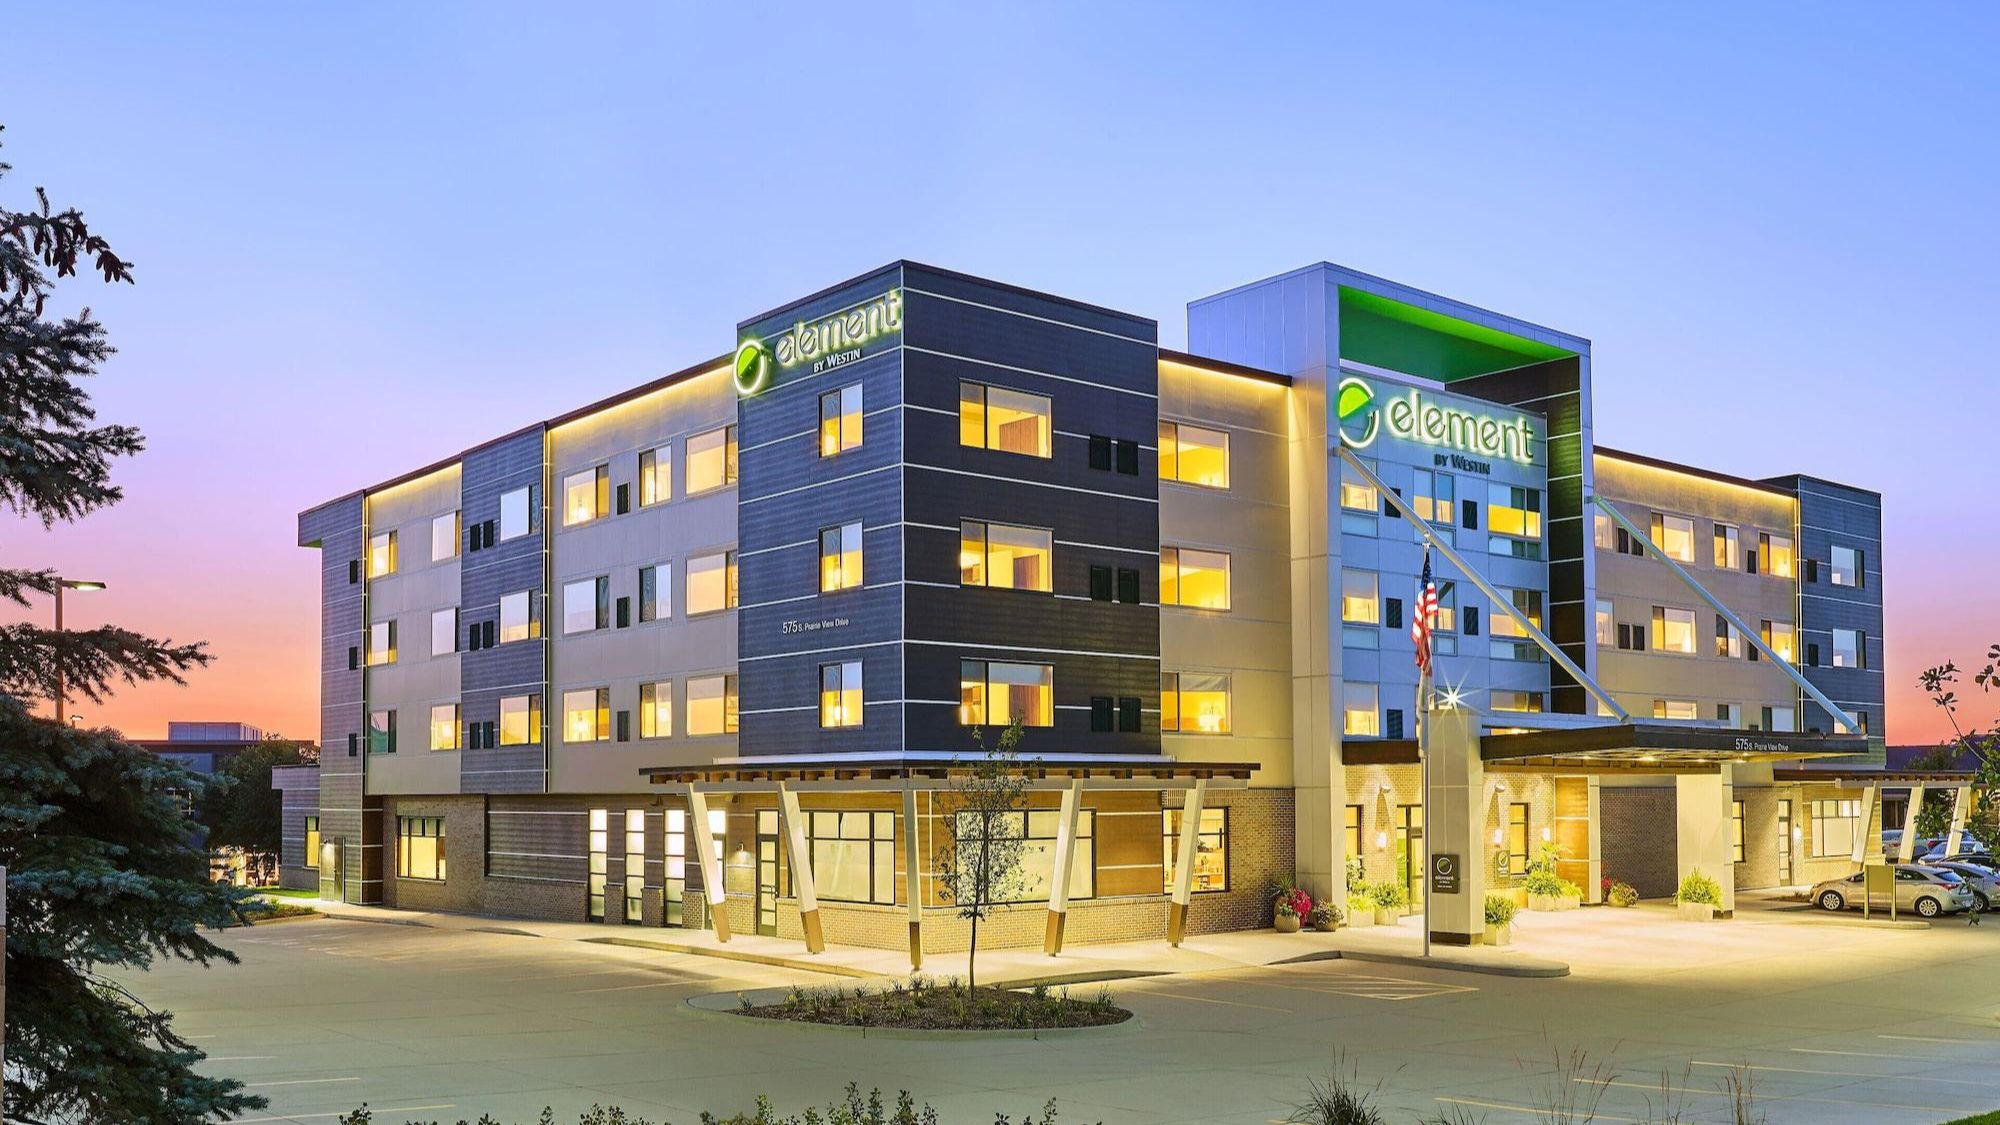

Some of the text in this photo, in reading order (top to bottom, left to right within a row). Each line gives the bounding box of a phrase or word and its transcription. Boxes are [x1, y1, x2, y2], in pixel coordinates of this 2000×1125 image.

[775, 294, 898, 364] element
[813, 361, 825, 373] BY
[1390, 392, 1534, 459] element
[1434, 453, 1449, 467] BY
[782, 620, 798, 634] 575
[1735, 738, 1749, 750] 575
